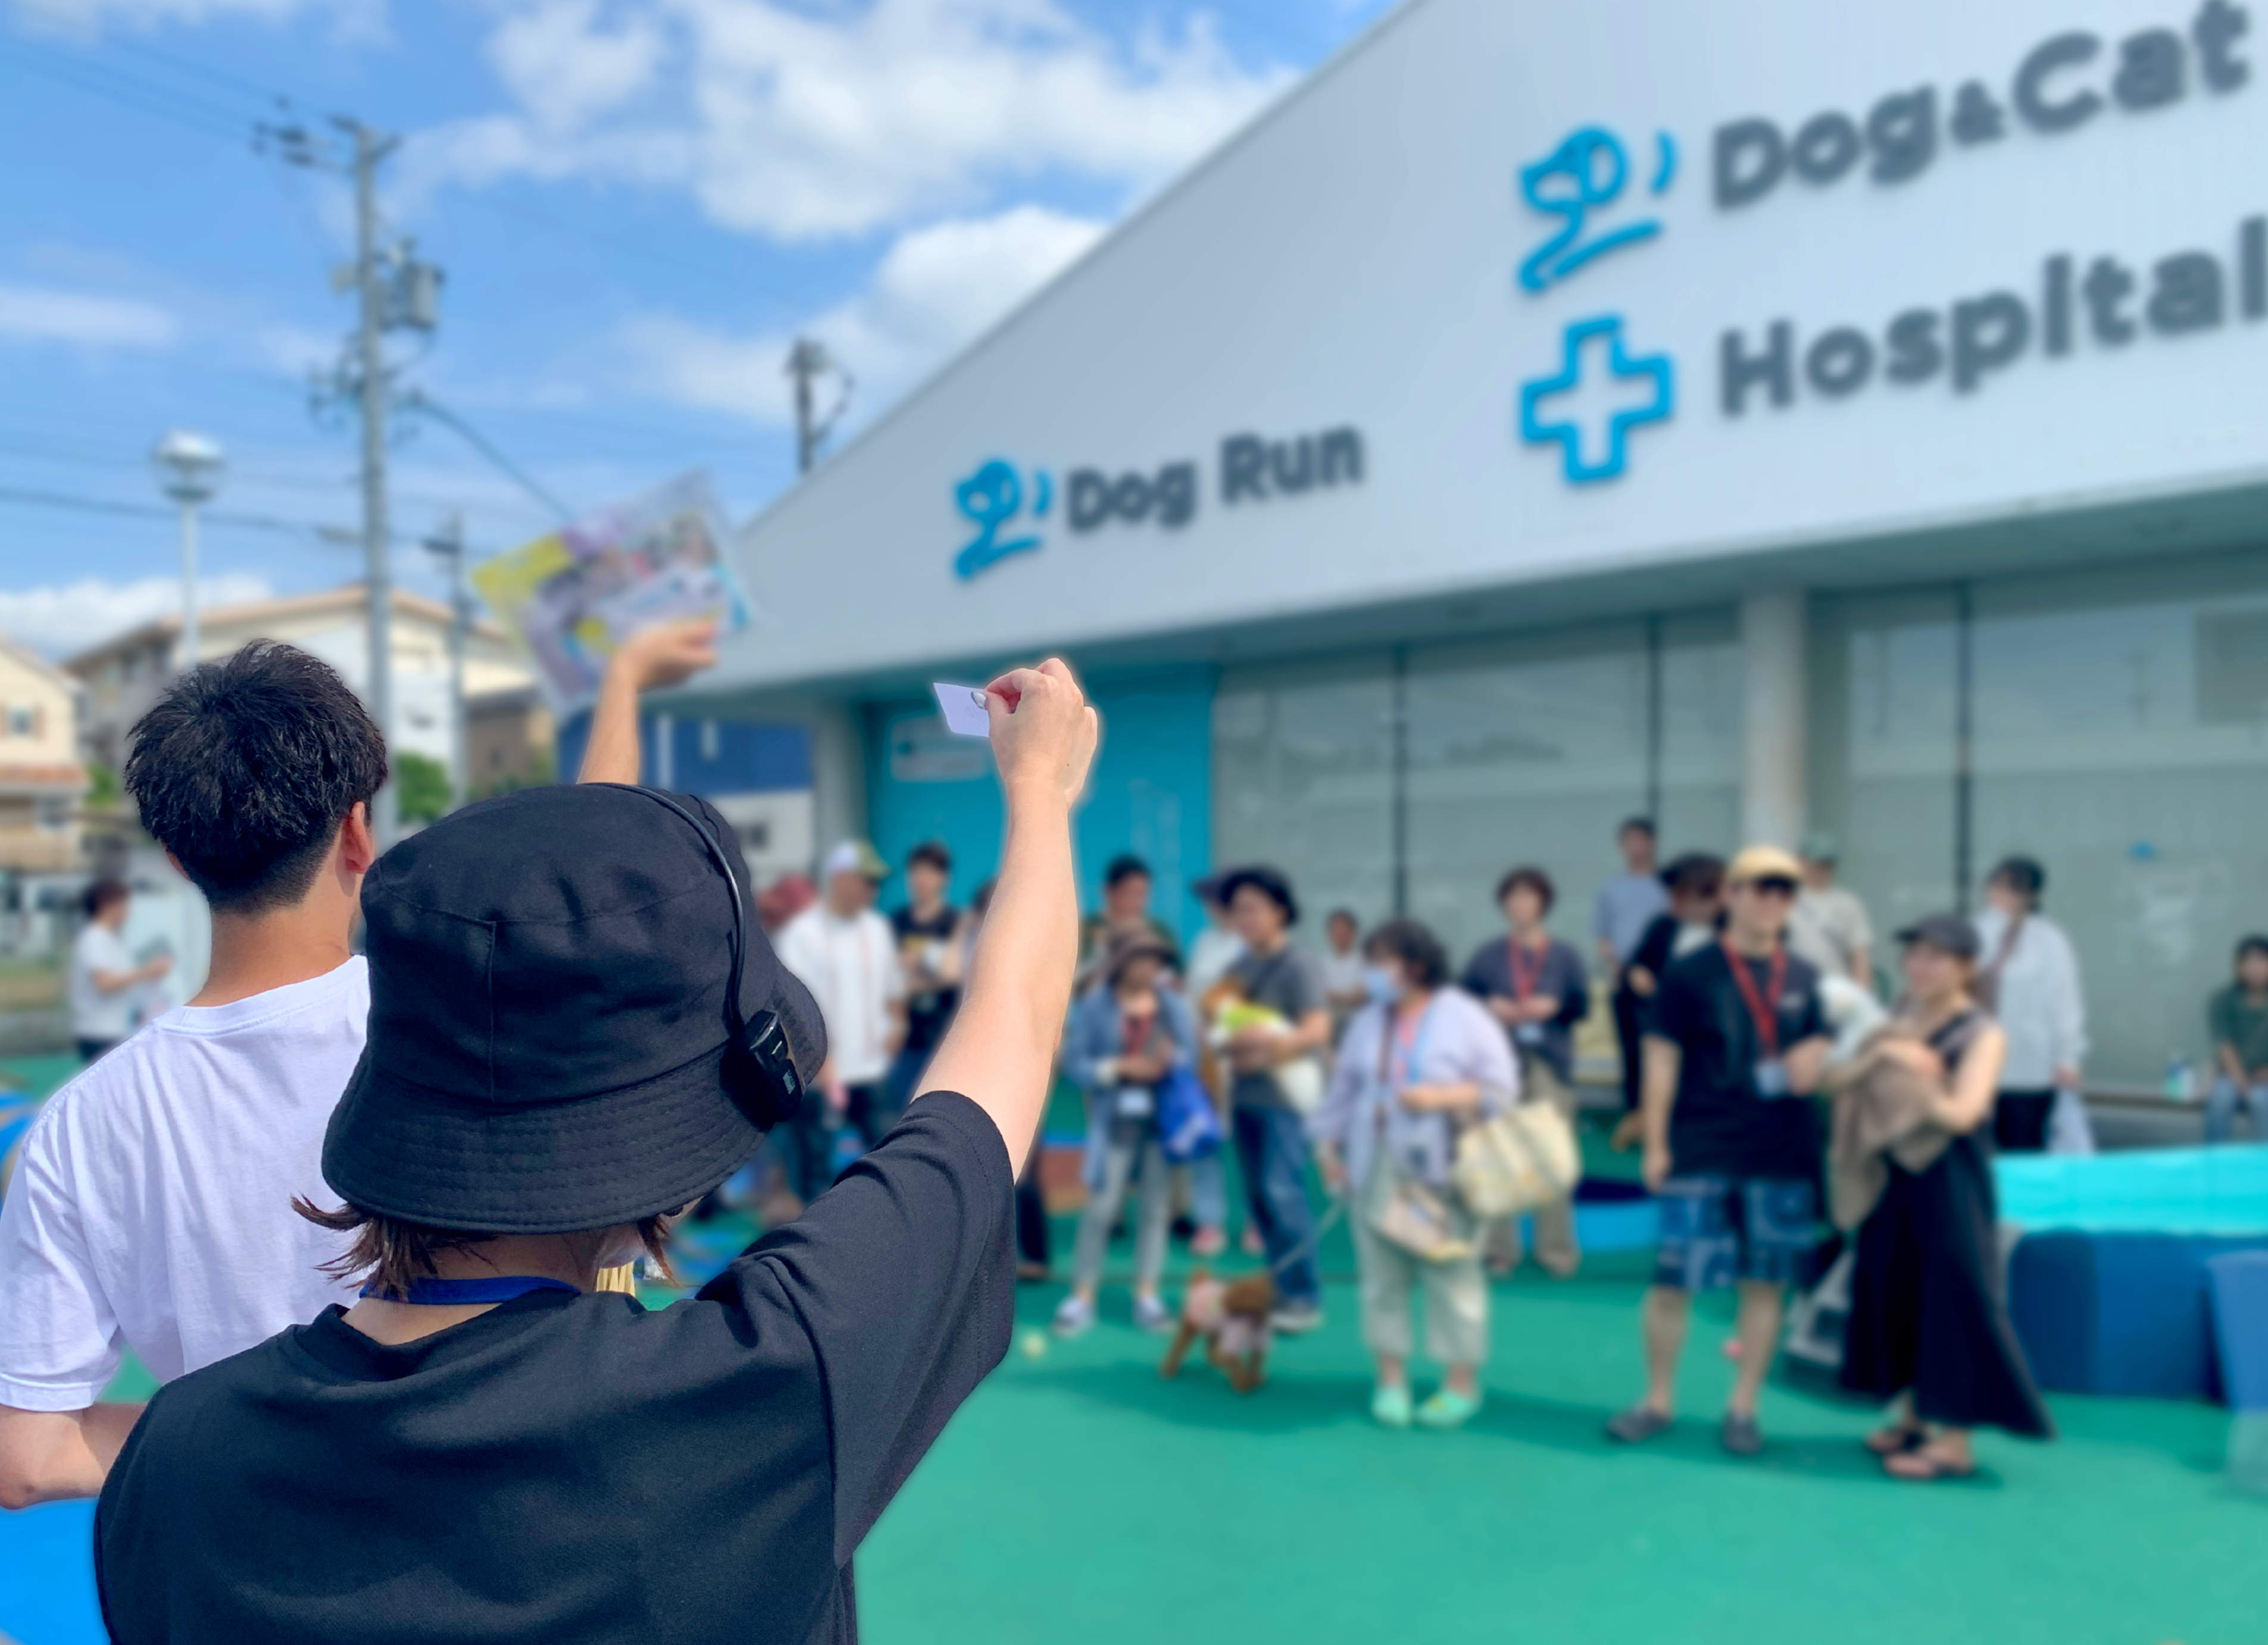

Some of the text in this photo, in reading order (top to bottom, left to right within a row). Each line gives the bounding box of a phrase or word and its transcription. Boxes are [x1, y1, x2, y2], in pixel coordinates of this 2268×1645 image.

[1717, 214, 2267, 418] Hospital
[1066, 428, 1362, 533] Dog Run
